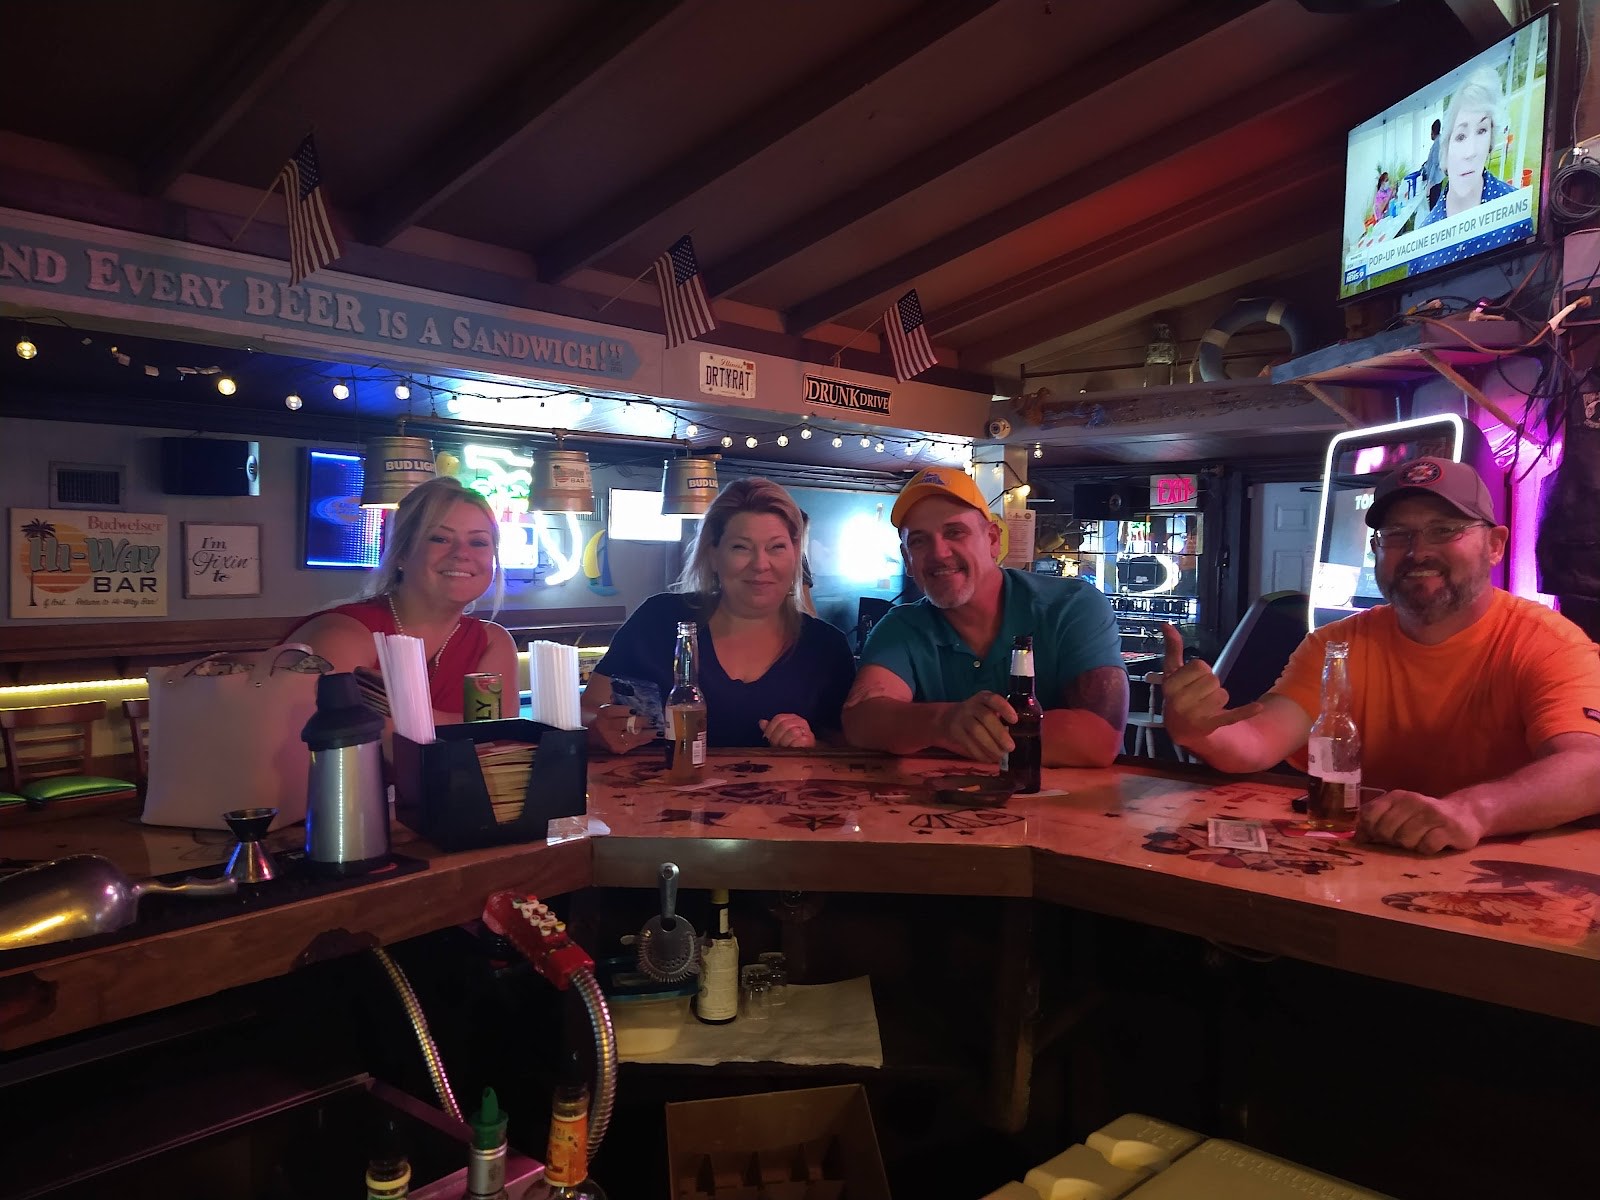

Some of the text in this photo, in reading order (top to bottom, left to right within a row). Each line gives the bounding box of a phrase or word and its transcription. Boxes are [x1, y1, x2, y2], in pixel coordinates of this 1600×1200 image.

[1368, 198, 1529, 267] POP-UP VACCINE EVENT FOR VETERANS
[86, 248, 230, 310] EVERY
[245, 276, 366, 334] BEER
[378, 307, 408, 340] IS
[419, 317, 442, 346] A
[706, 365, 751, 392] DRTYRAT
[807, 379, 889, 411] DRUNK DRIVE
[386, 461, 412, 471] BUD
[689, 479, 708, 488] BUD
[1158, 478, 1191, 503] EXIT
[87, 515, 163, 531] Budweiser
[201, 537, 227, 549] I'm
[213, 569, 230, 583] to
[93, 577, 157, 592] BAR
